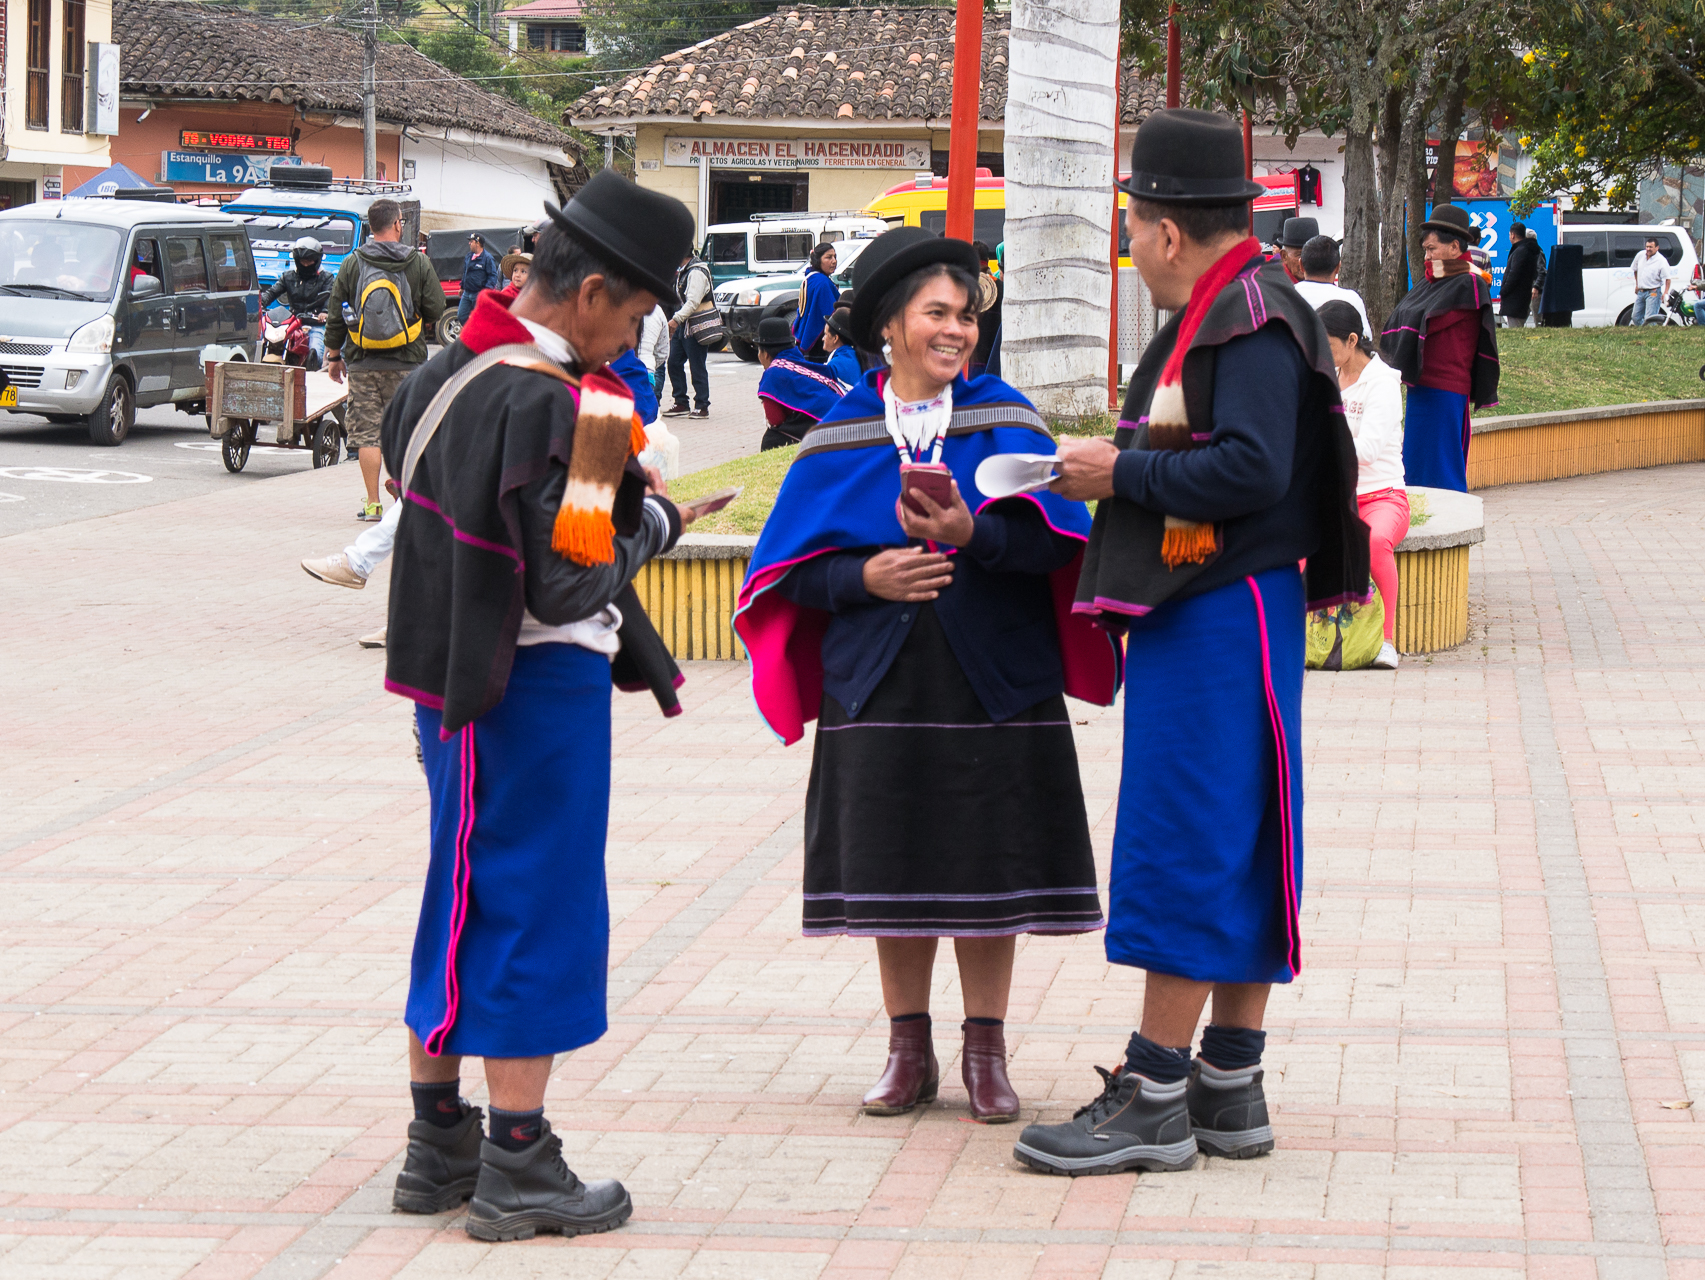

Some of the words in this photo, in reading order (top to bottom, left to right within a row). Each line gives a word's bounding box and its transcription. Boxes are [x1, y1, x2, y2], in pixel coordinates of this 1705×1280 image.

[209, 133, 256, 148] VODKA
[691, 141, 770, 157] ALMACEN
[775, 143, 797, 158] EL
[804, 142, 905, 158] HACENDADO
[170, 152, 222, 166] Estanquillo
[689, 156, 728, 165] PRCTOS
[731, 157, 767, 166] AGRICOLAS
[768, 158, 773, 166] Y
[774, 158, 820, 167] VETERINARIOS
[824, 158, 866, 167] FERRETERIA
[877, 159, 907, 167] GENERAL
[205, 164, 227, 182] La
[232, 165, 258, 183] 9A
